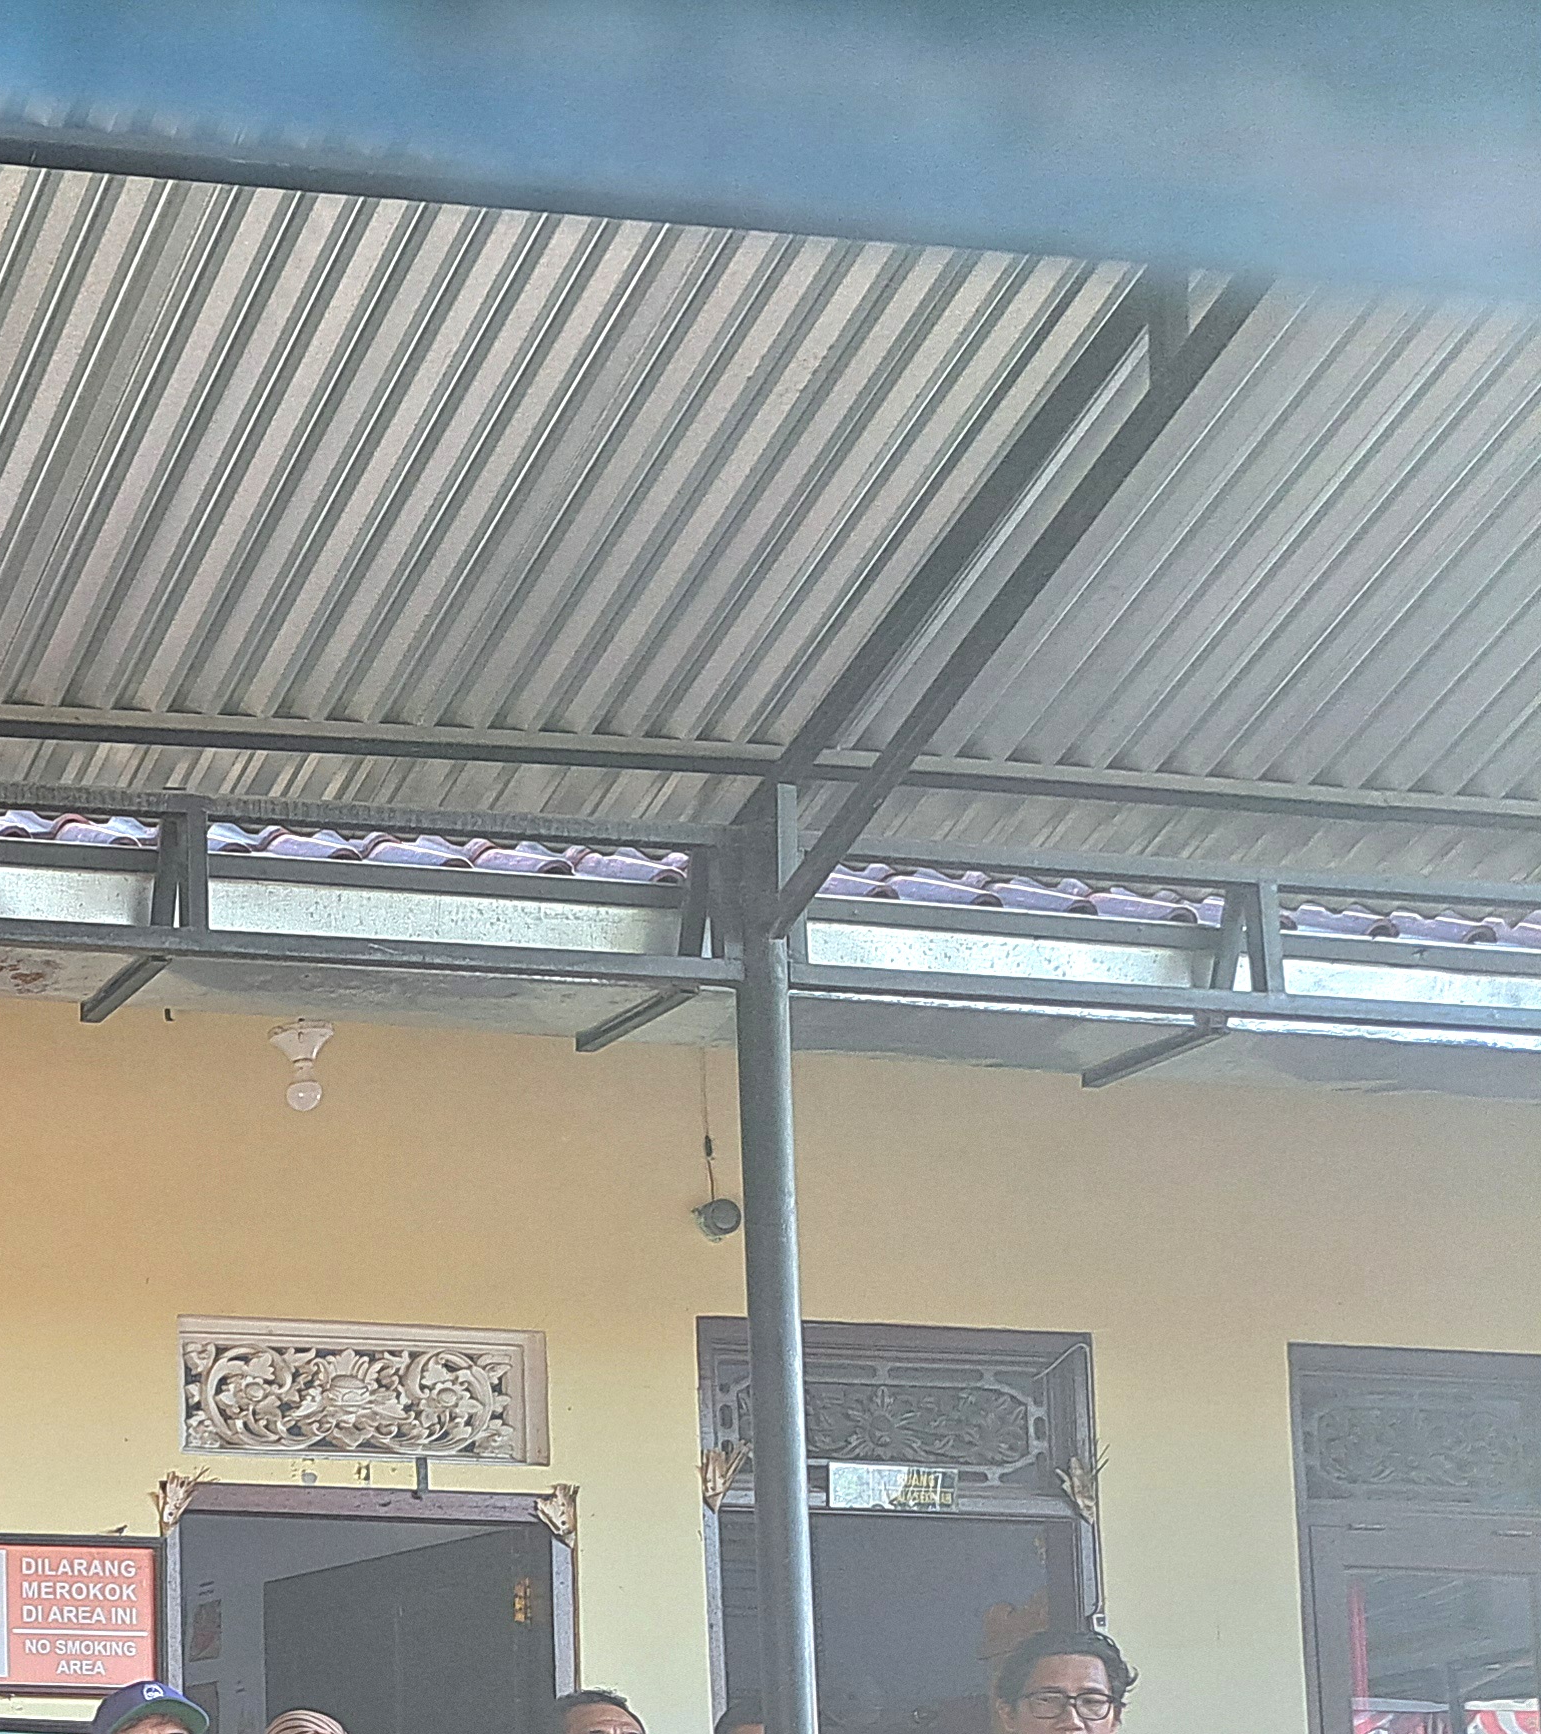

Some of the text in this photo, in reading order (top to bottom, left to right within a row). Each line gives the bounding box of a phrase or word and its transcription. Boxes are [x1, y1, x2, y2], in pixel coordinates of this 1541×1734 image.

[22, 1558, 136, 1578] DILARANG
[22, 1582, 137, 1602] MEROKOK
[22, 1605, 137, 1625] DI AREA INI
[25, 1639, 136, 1657] NO SMOKING
[56, 1660, 105, 1675] AREA
